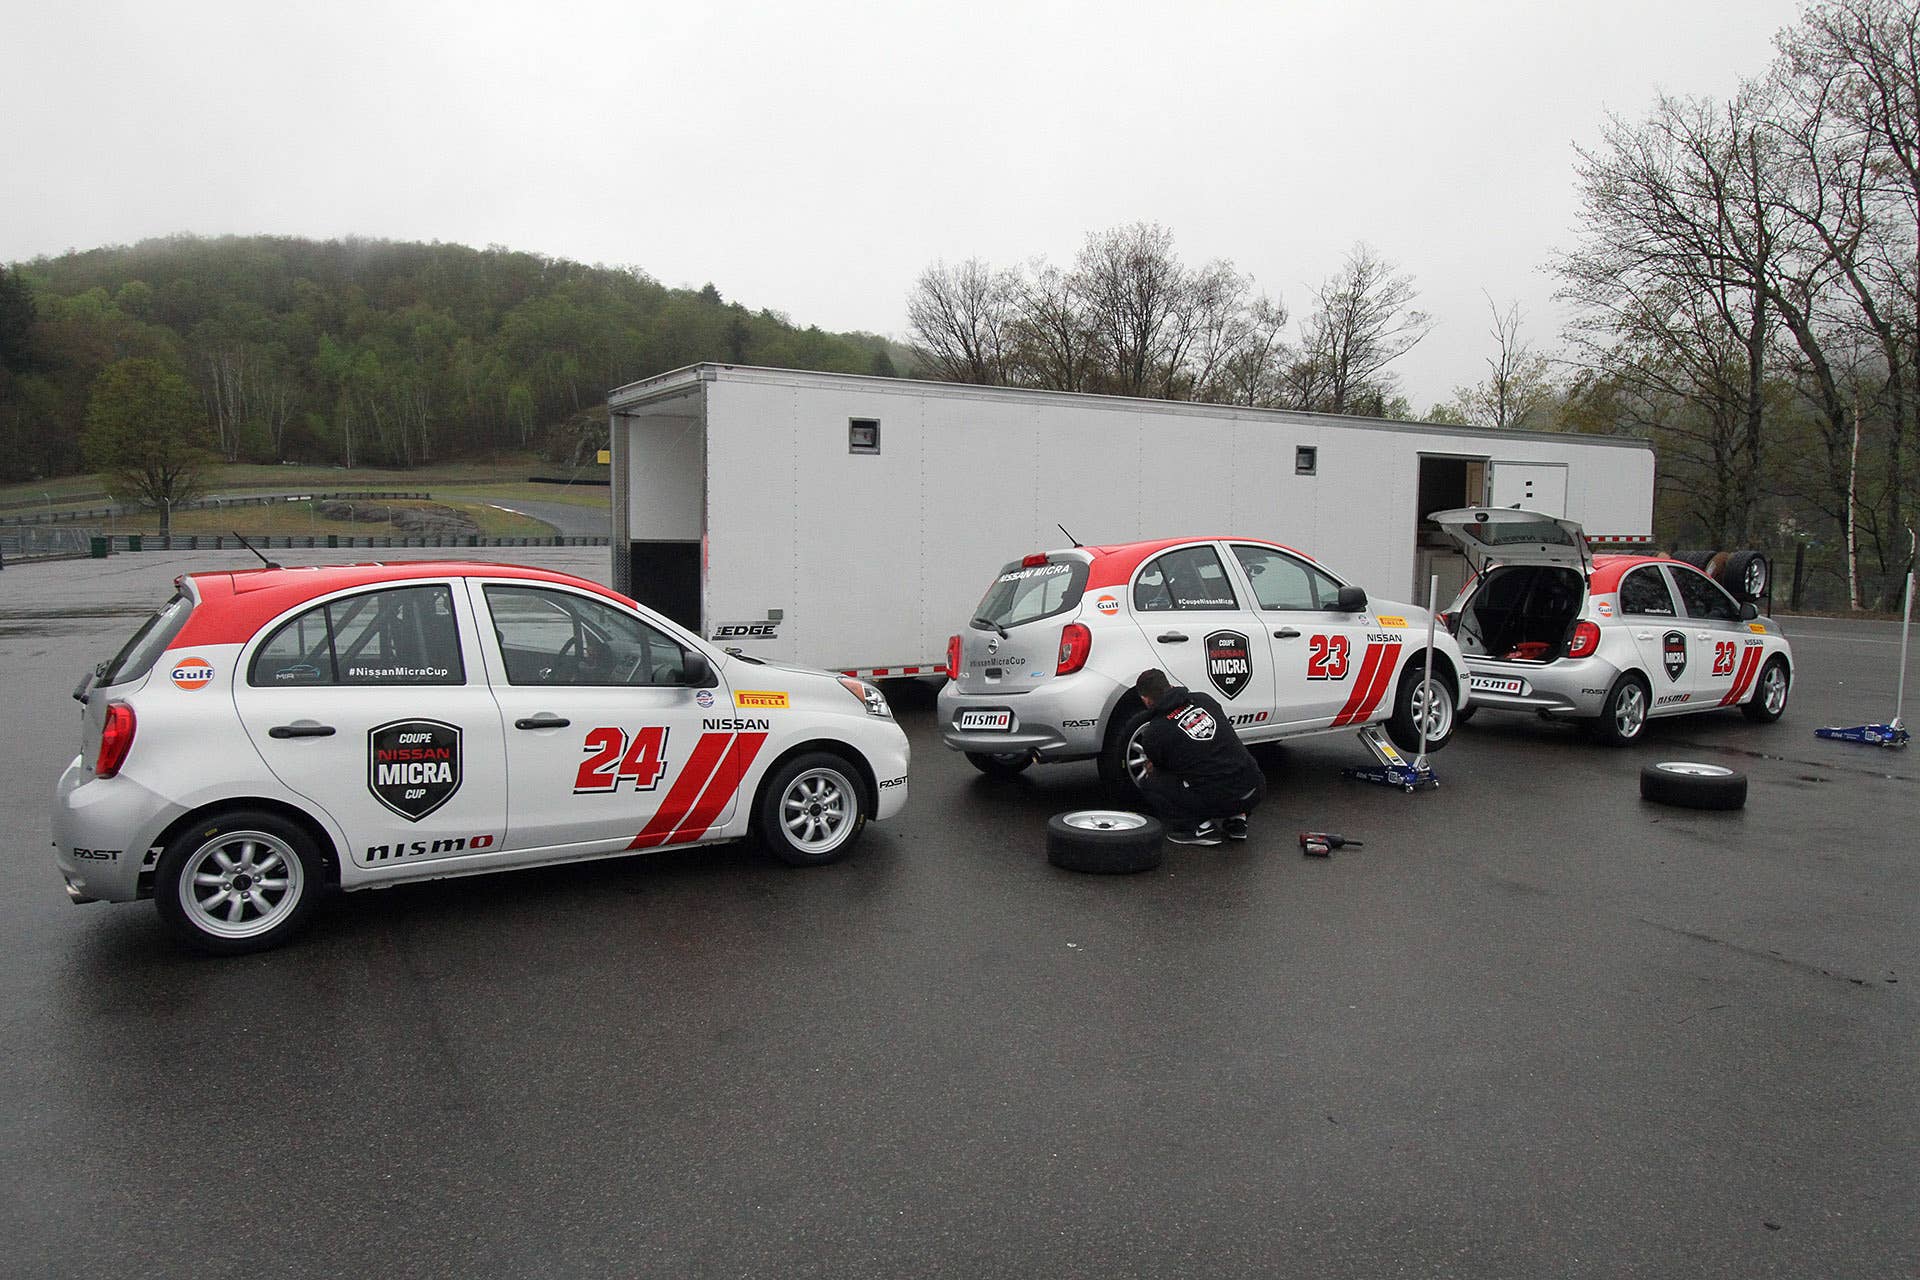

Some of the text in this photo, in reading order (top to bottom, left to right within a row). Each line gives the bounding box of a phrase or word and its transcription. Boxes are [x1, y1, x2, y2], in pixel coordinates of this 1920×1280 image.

[999, 564, 1070, 583] NISSAN MICRA
[1097, 602, 1119, 610] Gulf
[721, 625, 776, 636] EDGE
[1218, 639, 1236, 647] COUPE
[1367, 633, 1403, 642] NISSAN
[1307, 634, 1351, 681] 23
[1665, 652, 1685, 664] MICRA
[1711, 641, 1737, 677] 23
[349, 667, 449, 678] #NissanMicraCup
[1211, 659, 1249, 675] MICRA
[171, 668, 214, 681] Gulf
[1225, 677, 1237, 685] CUP
[739, 693, 786, 706] PIRELLI
[1657, 694, 1690, 704] nismo
[702, 719, 770, 730] NISSAN
[963, 715, 1008, 726] nismo
[1062, 719, 1099, 728] FAST
[1228, 711, 1269, 726] smo
[399, 733, 432, 744] COUPE
[378, 748, 450, 761] NISSAN
[573, 726, 670, 795] 24
[378, 762, 453, 786] MICRA
[880, 775, 909, 789] FAST
[405, 788, 426, 800] CUP
[73, 847, 123, 861] FAST
[366, 835, 493, 861] nismo
